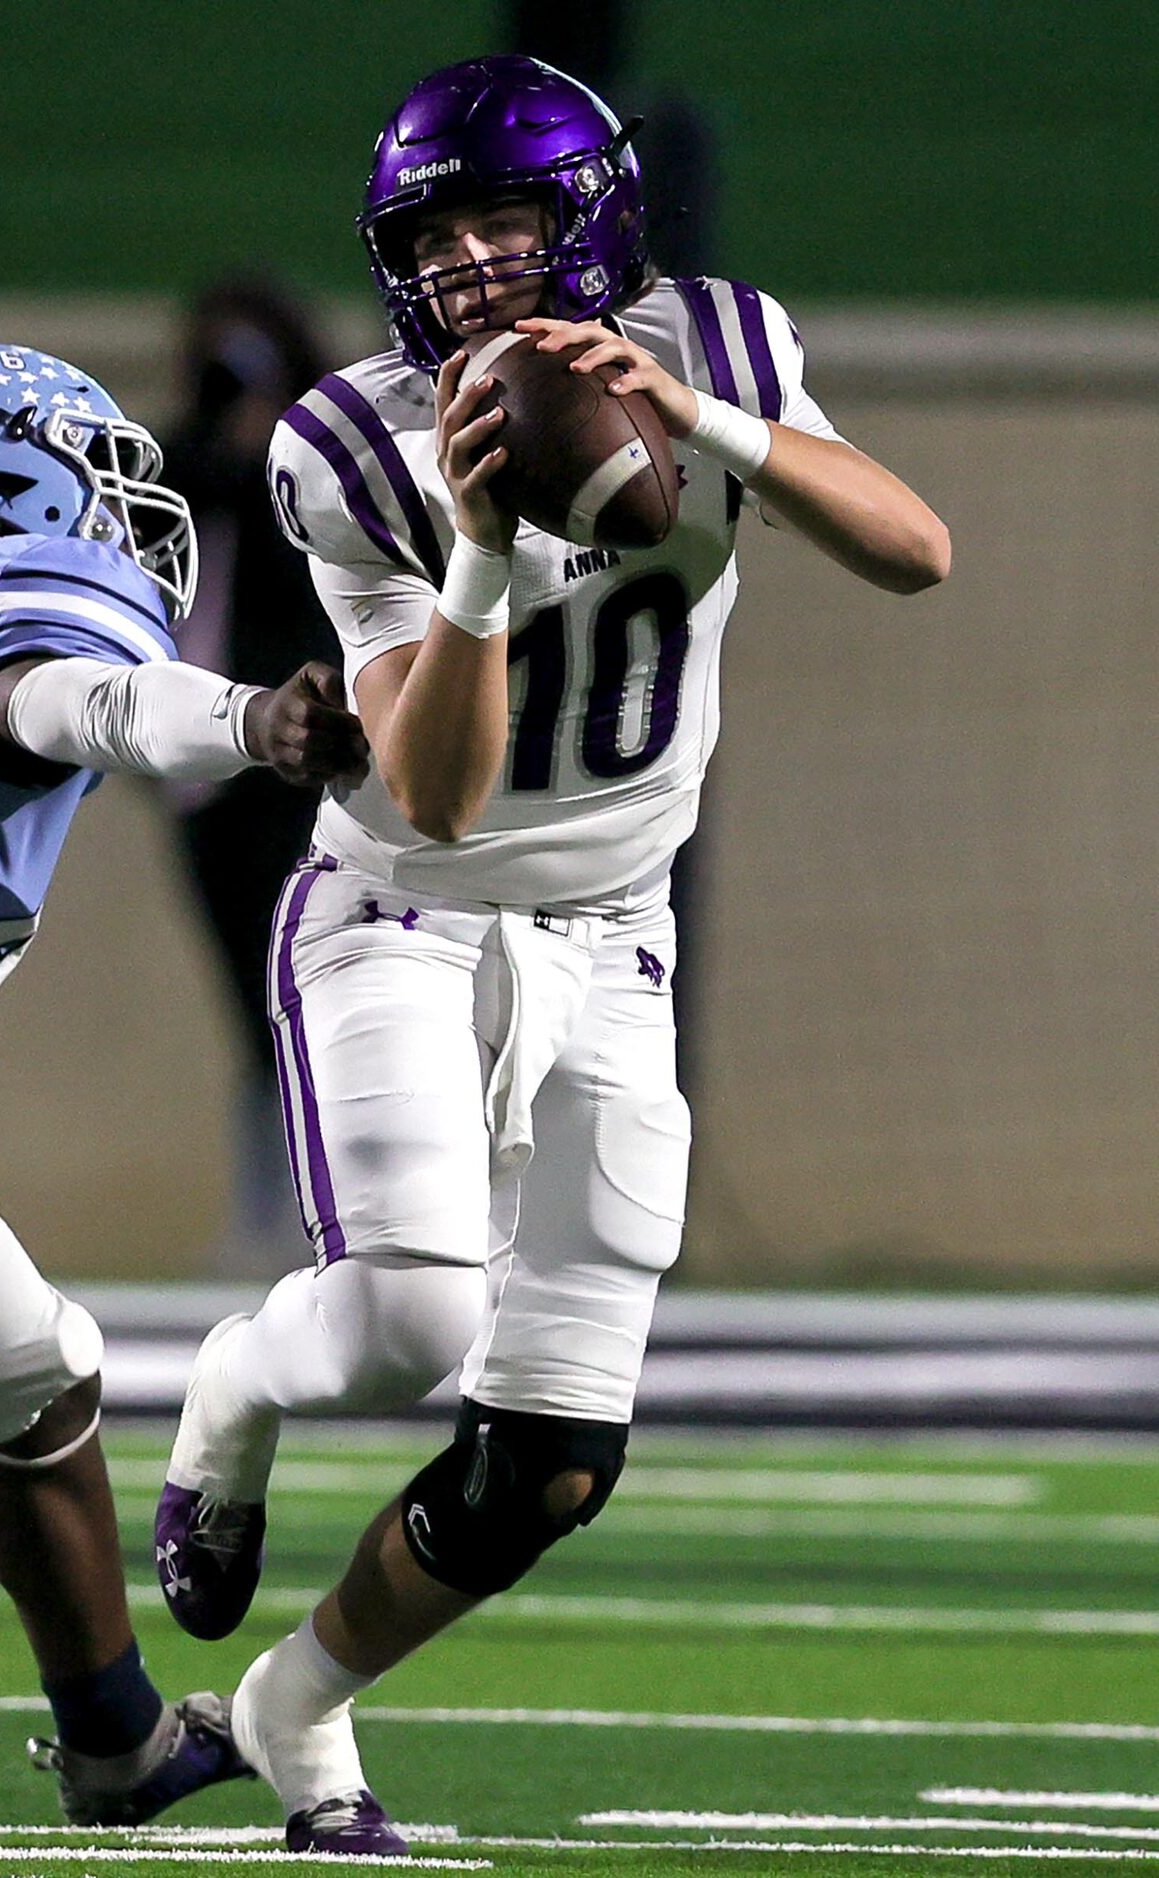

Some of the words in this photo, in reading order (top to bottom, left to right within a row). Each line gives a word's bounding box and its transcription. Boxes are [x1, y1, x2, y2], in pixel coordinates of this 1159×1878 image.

[397, 158, 461, 186] Riddell
[563, 548, 620, 582] ANNA
[507, 569, 693, 792] 10
